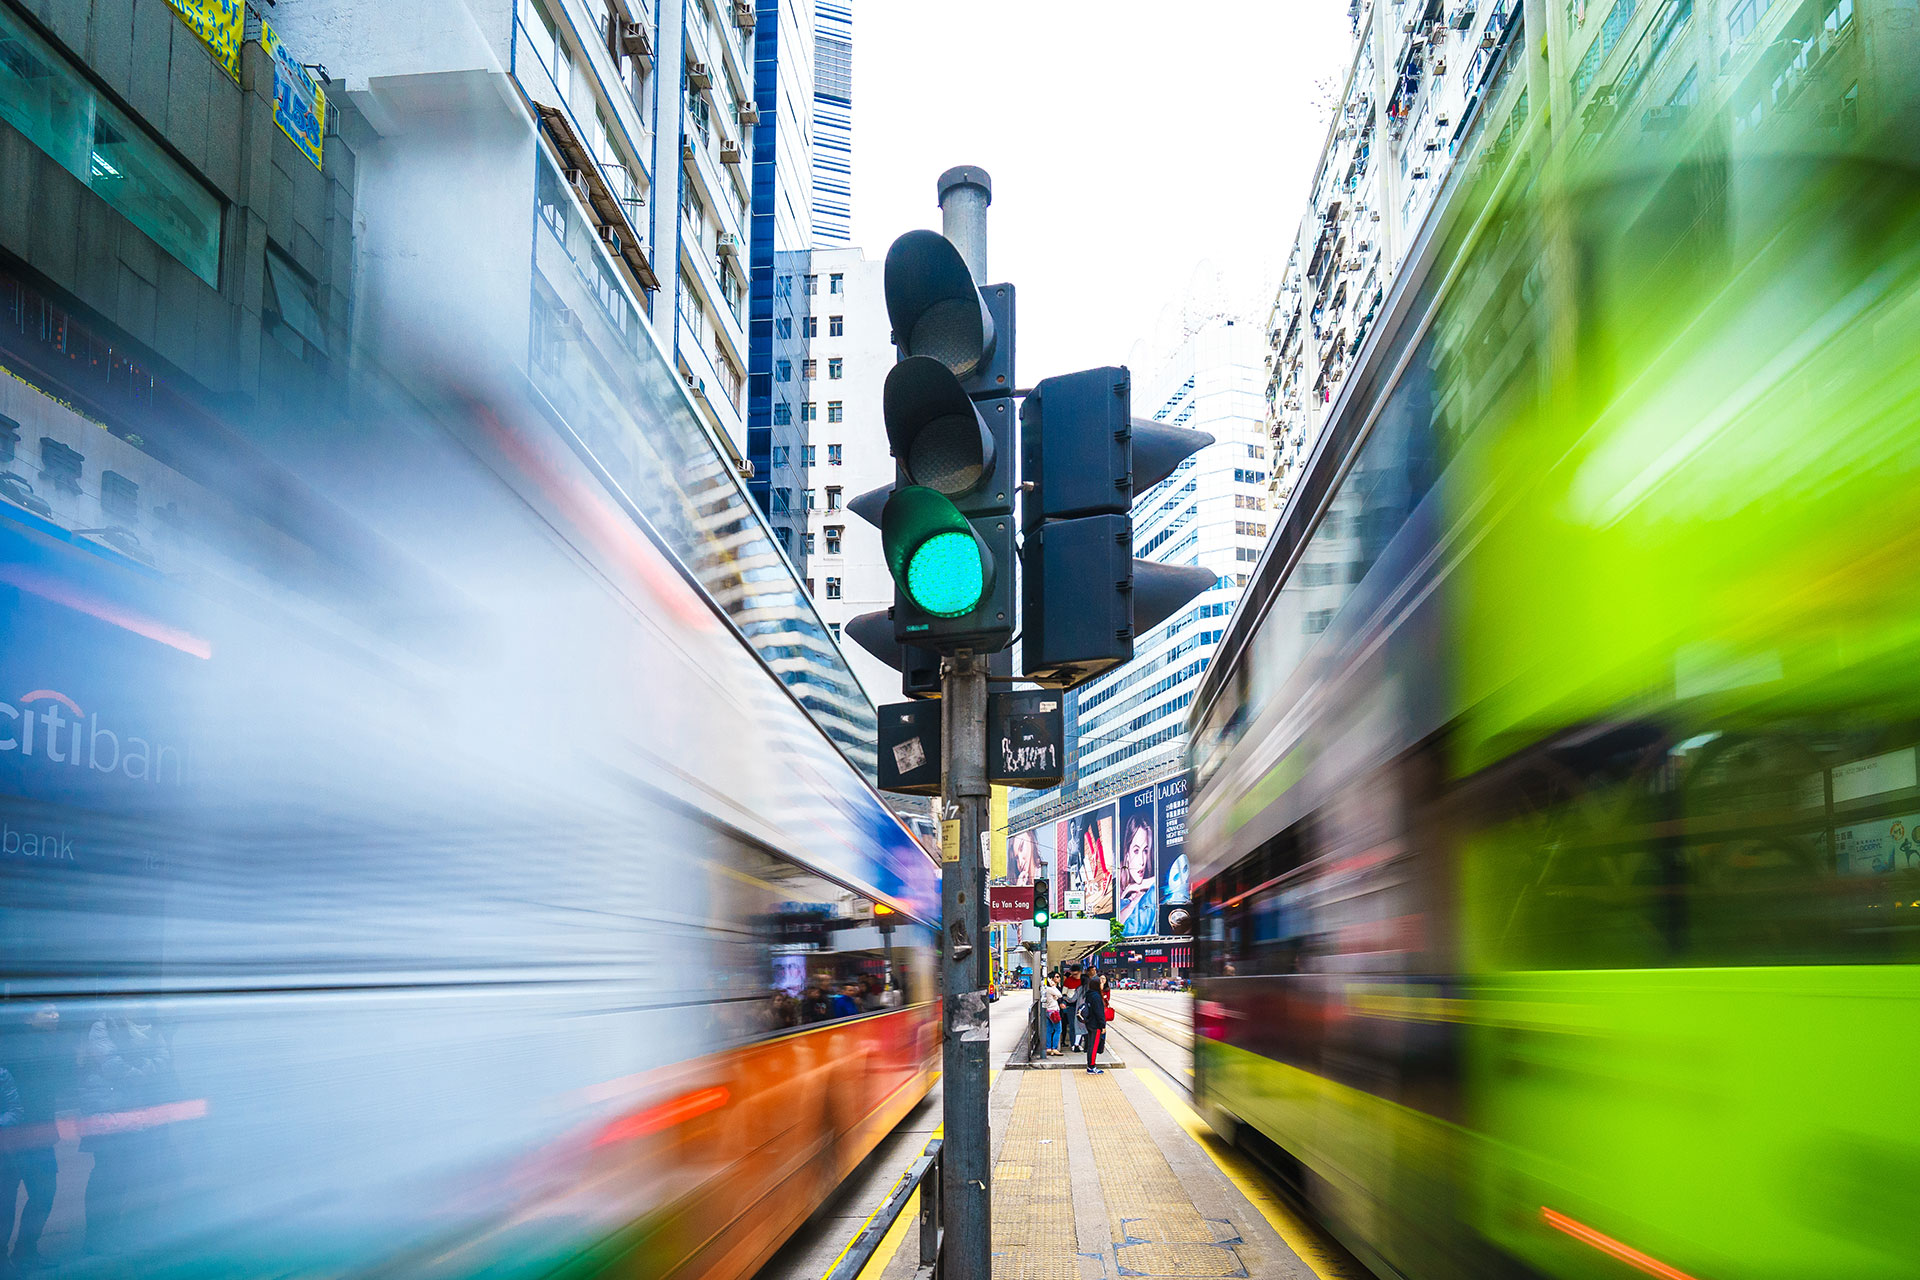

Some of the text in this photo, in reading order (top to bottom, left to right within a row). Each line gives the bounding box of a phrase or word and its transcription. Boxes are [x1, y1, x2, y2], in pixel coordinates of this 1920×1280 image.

[266, 26, 317, 97] Facial
[0, 700, 188, 787] citiban
[1134, 789, 1154, 808] ESTÉE
[1158, 779, 1187, 800] LAUDER
[2, 823, 74, 861] bank
[992, 900, 1000, 909] Eu
